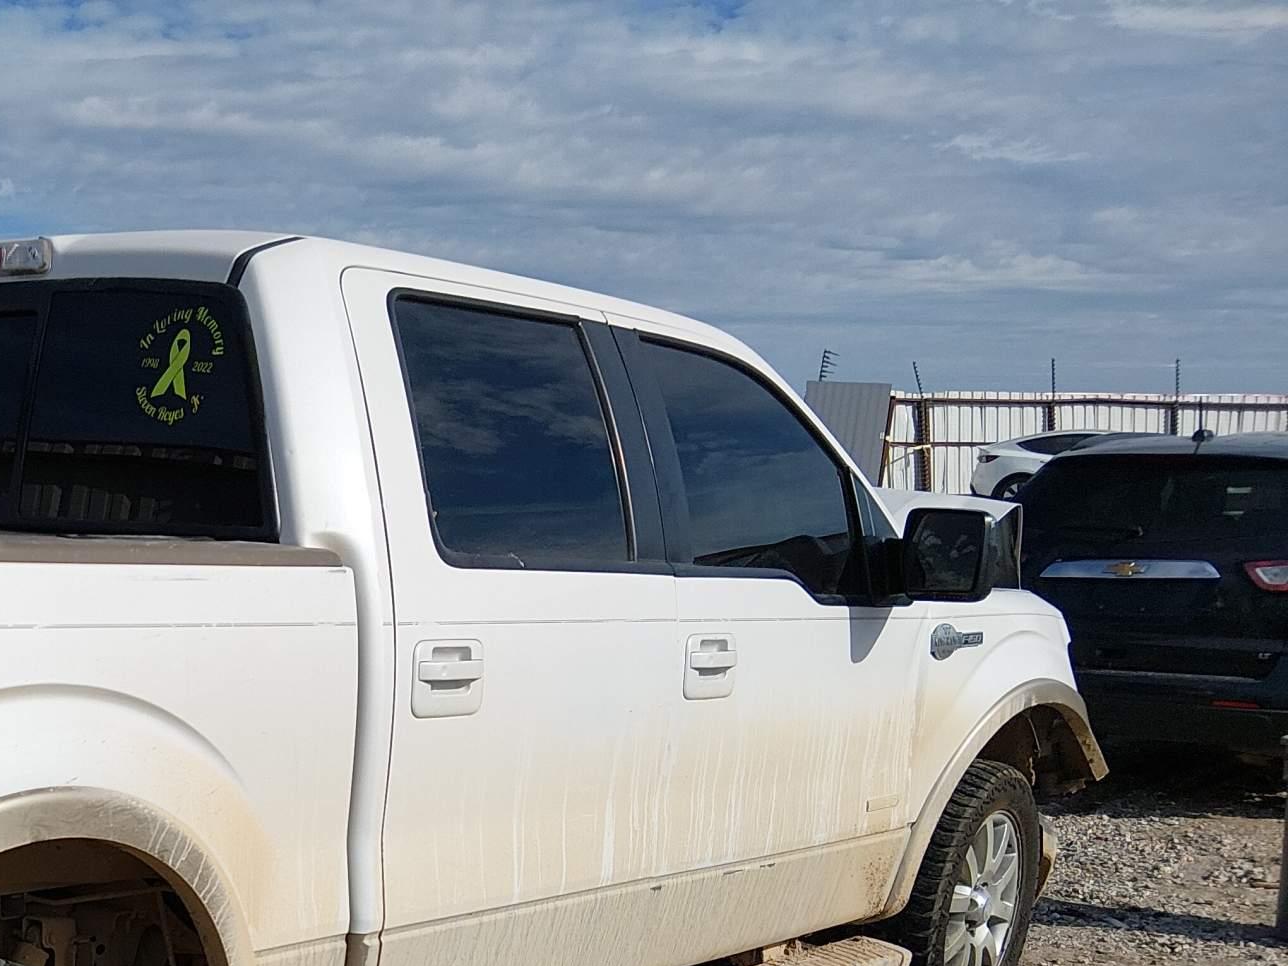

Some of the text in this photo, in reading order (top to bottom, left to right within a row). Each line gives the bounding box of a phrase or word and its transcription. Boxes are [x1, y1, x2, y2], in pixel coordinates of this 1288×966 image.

[139, 306, 225, 356] In Loving Memory
[192, 361, 214, 374] 2022
